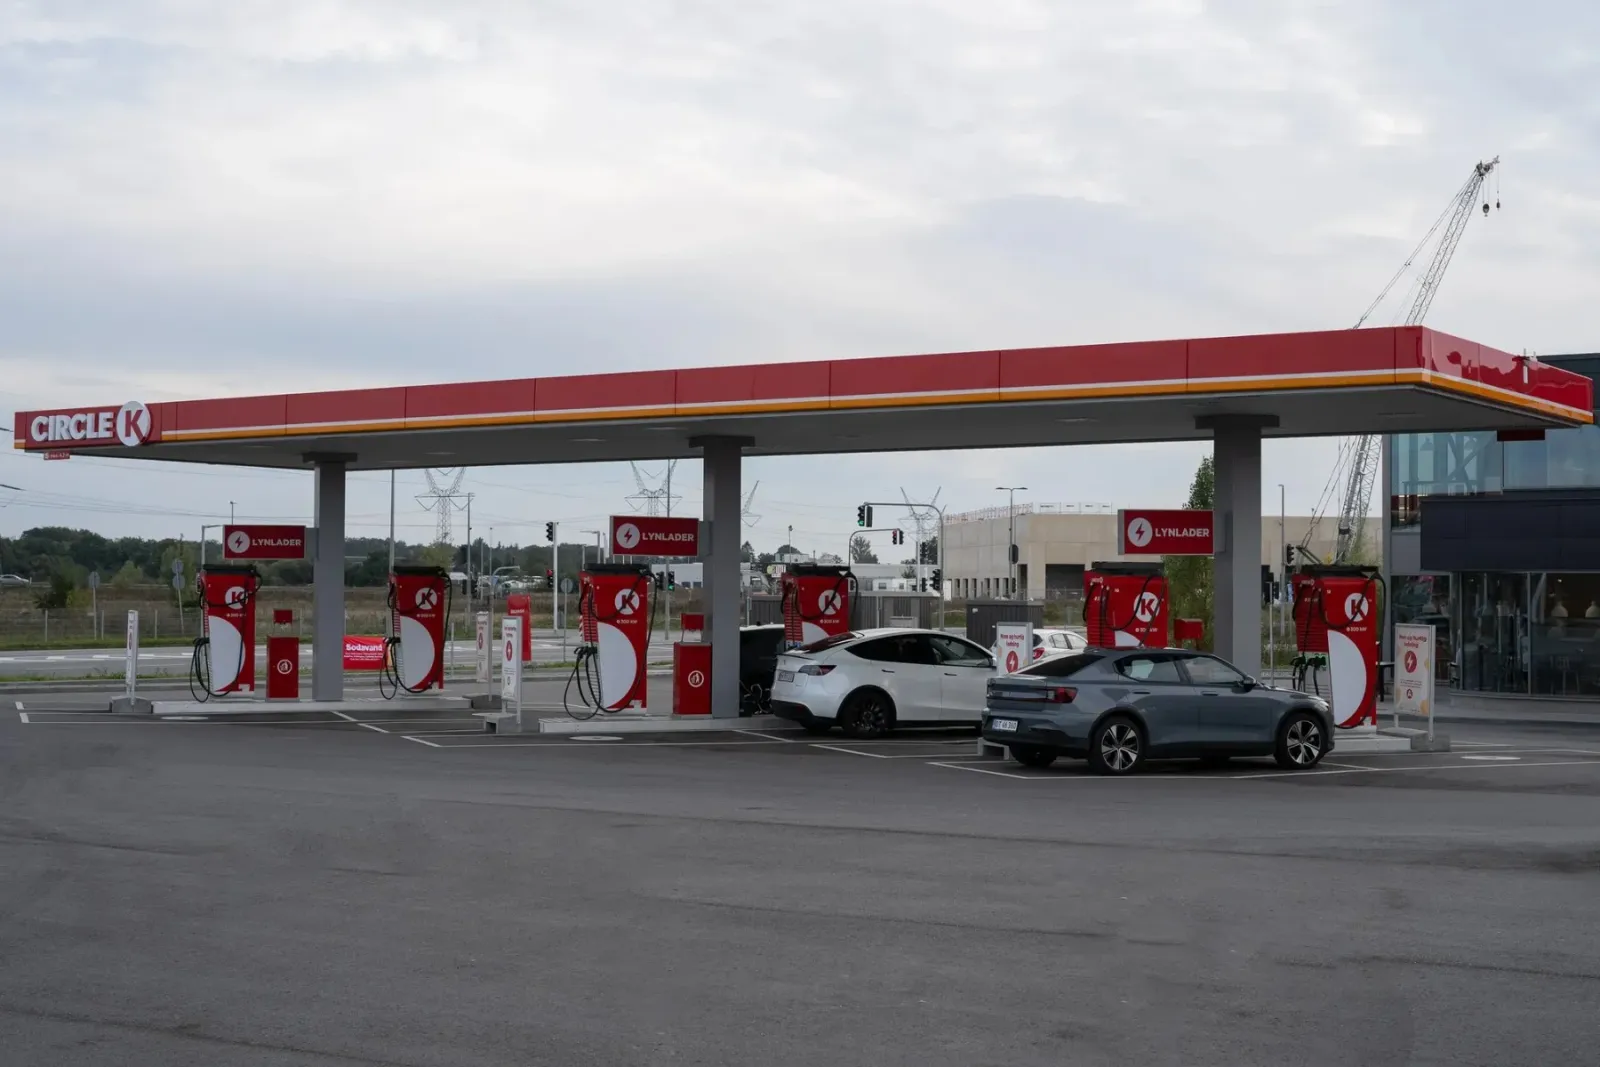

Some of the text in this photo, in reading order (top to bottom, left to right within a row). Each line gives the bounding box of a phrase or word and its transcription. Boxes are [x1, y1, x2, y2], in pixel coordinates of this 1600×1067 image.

[31, 412, 114, 442] CIRCLE
[642, 532, 695, 541] LYNLADER
[1155, 528, 1209, 537] LYNLADER
[252, 538, 301, 546] LYNLADER
